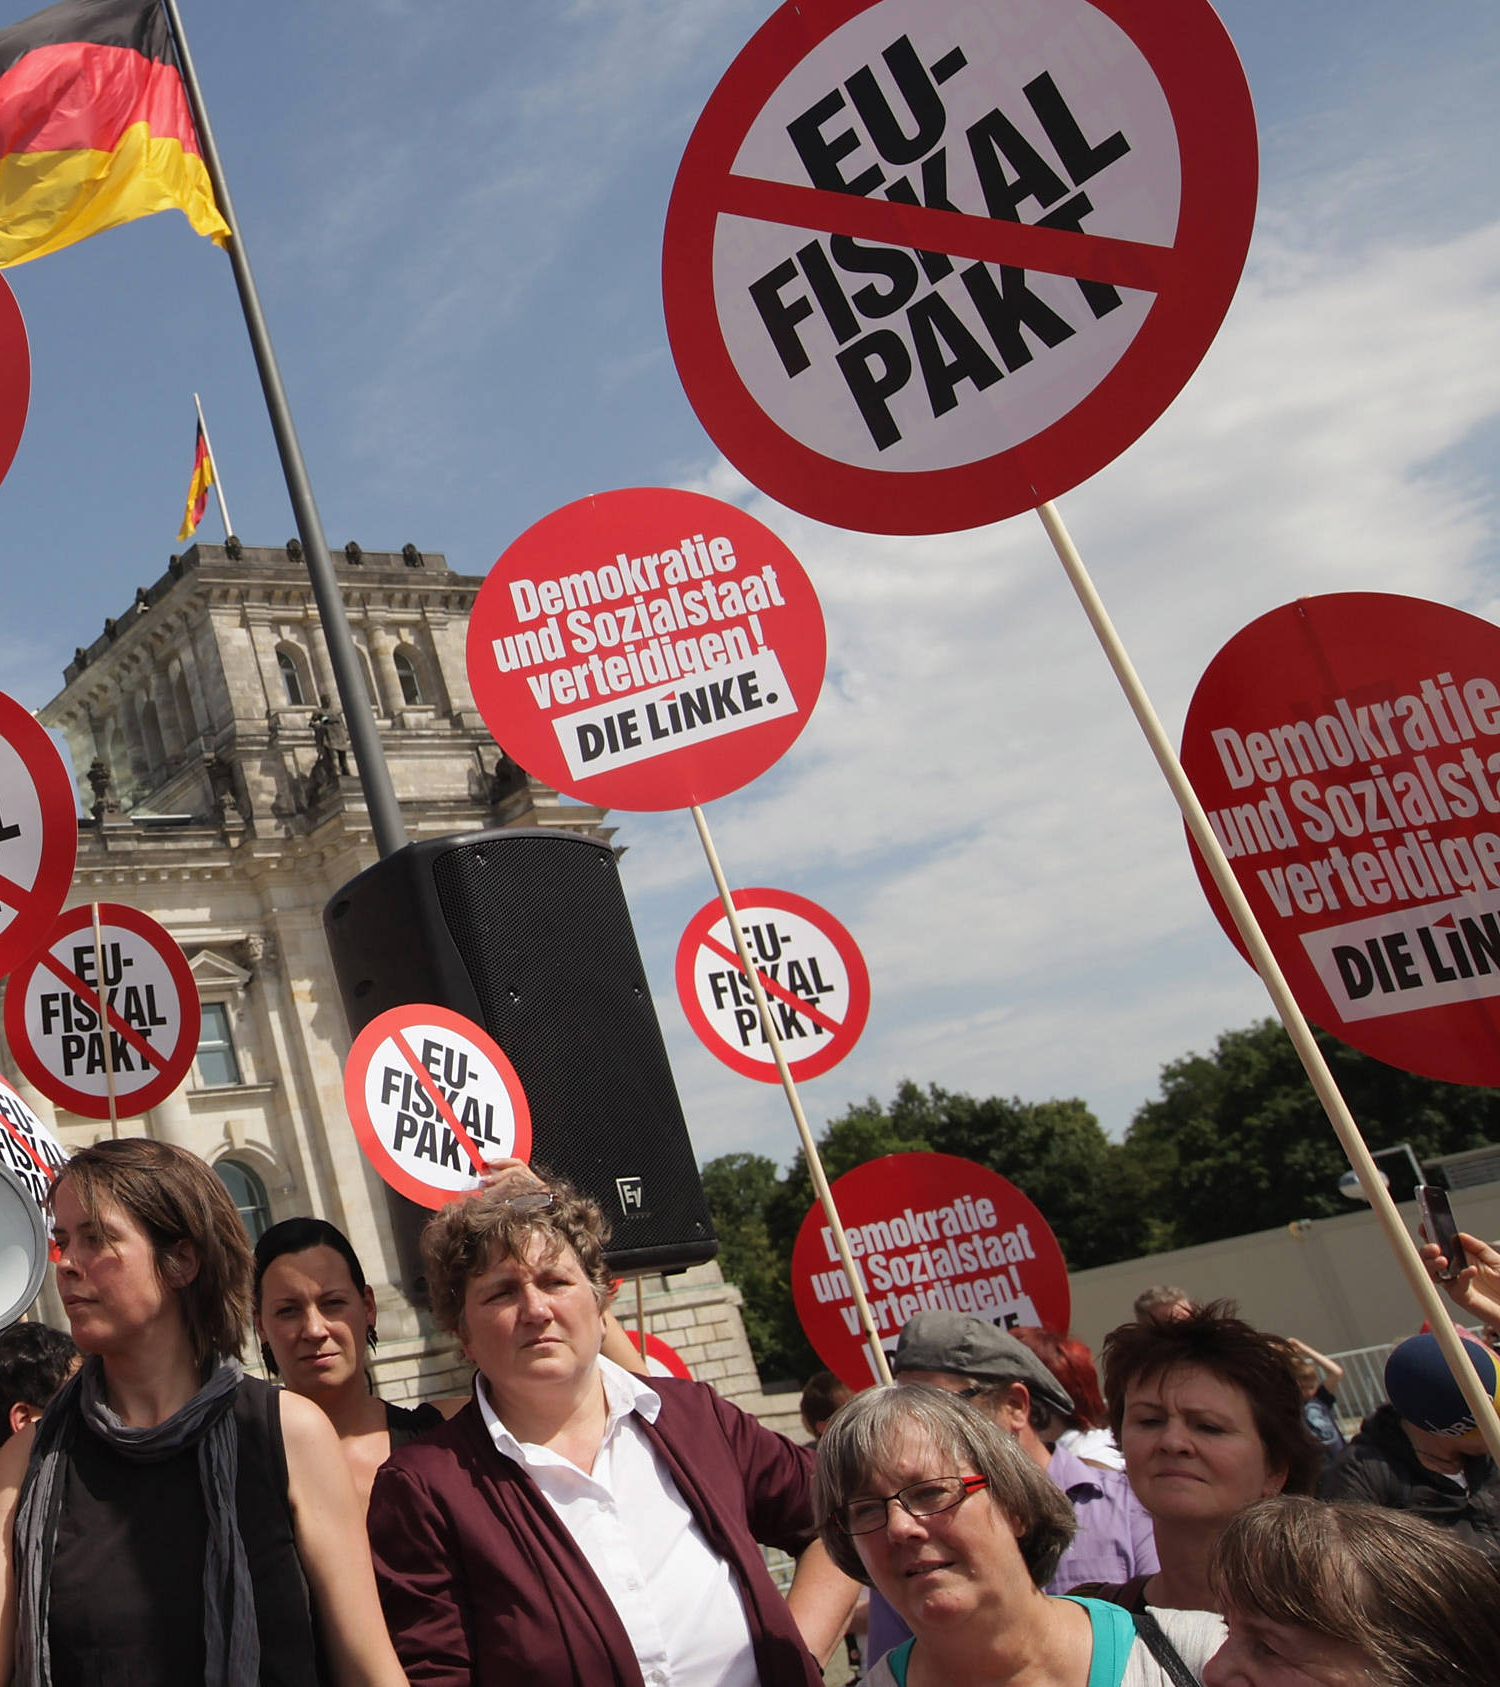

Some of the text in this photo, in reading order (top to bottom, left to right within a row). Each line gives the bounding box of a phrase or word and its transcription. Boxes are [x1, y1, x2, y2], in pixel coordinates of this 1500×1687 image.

[786, 34, 968, 197] EU-
[749, 70, 1131, 378] FISKAL
[835, 191, 1123, 452] PAKT
[492, 564, 785, 673] und Sozialstaat
[509, 534, 737, 623] Demokratie
[526, 614, 768, 710] verteidigen!
[576, 709, 642, 763] DIE
[1211, 672, 1500, 790] Demokratie
[1208, 787, 1299, 860] und
[73, 943, 134, 988] EU-
[1331, 931, 1424, 1001] DIE
[381, 1066, 501, 1145] FISKAL
[421, 1038, 479, 1090] EU-
[867, 1223, 1036, 1291] Sozialstaat
